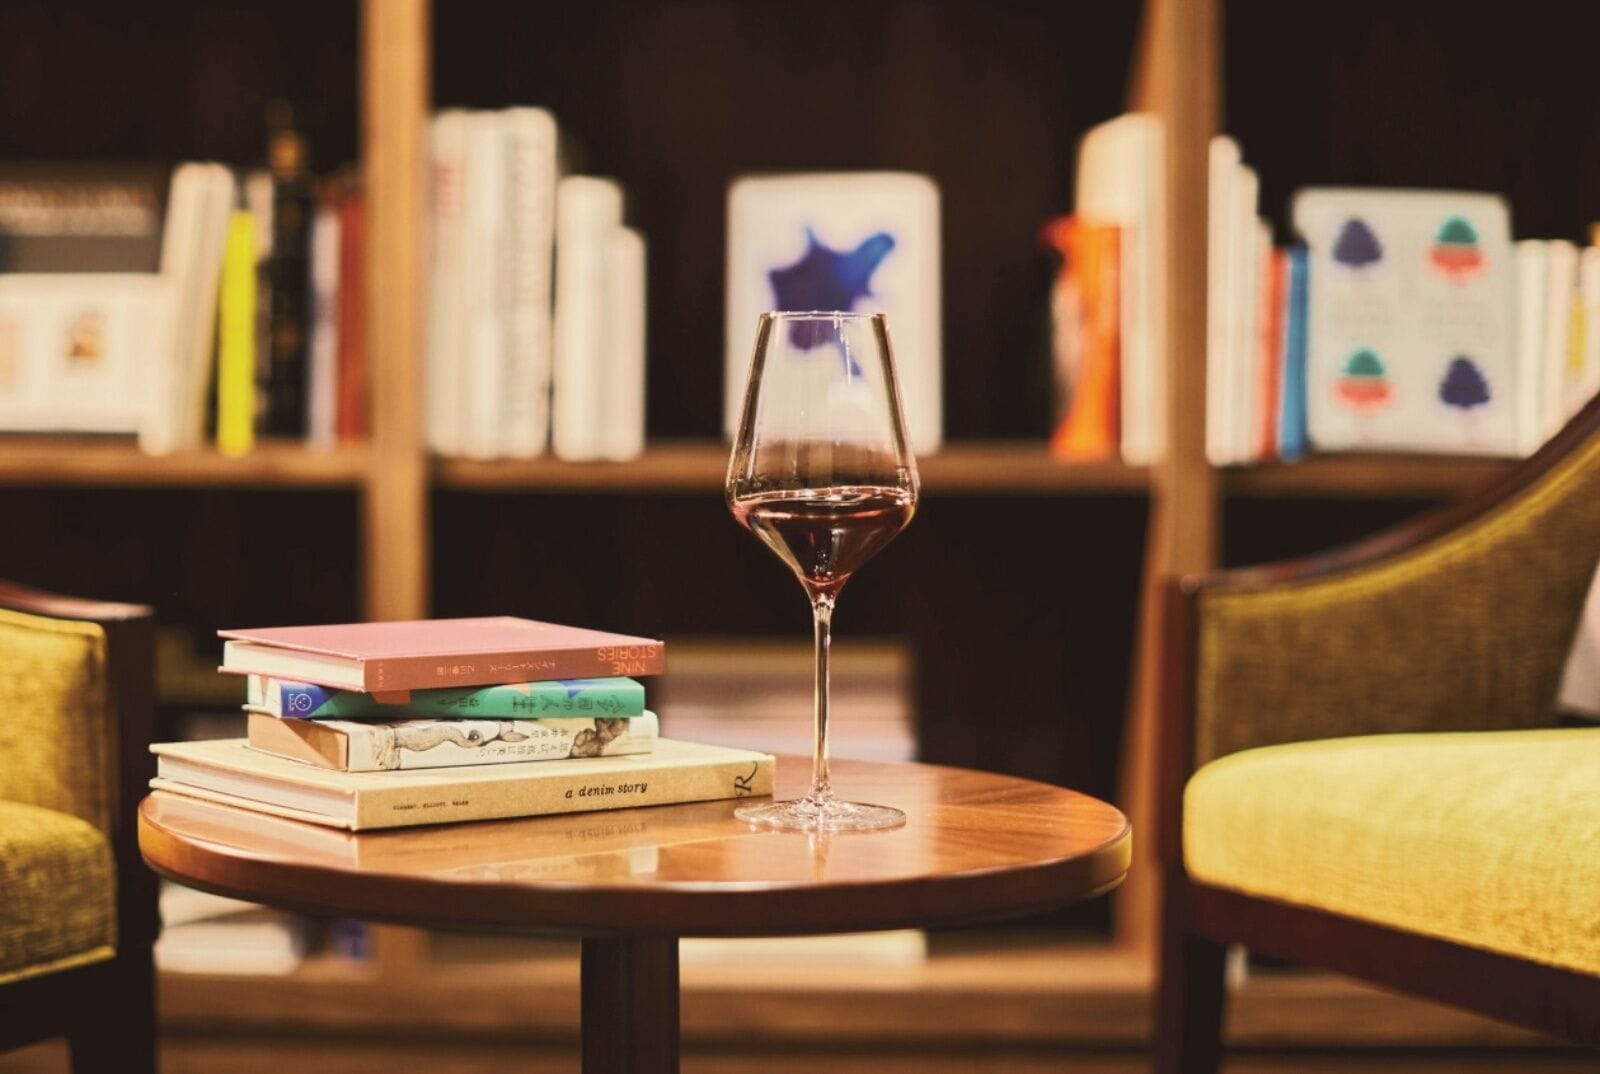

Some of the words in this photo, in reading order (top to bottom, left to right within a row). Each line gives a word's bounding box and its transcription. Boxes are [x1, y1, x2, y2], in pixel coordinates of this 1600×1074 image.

[597, 647, 656, 661] STORIES
[613, 661, 646, 674] NINE
[565, 788, 572, 799] a
[579, 780, 613, 798] denim
[617, 780, 648, 796] story
